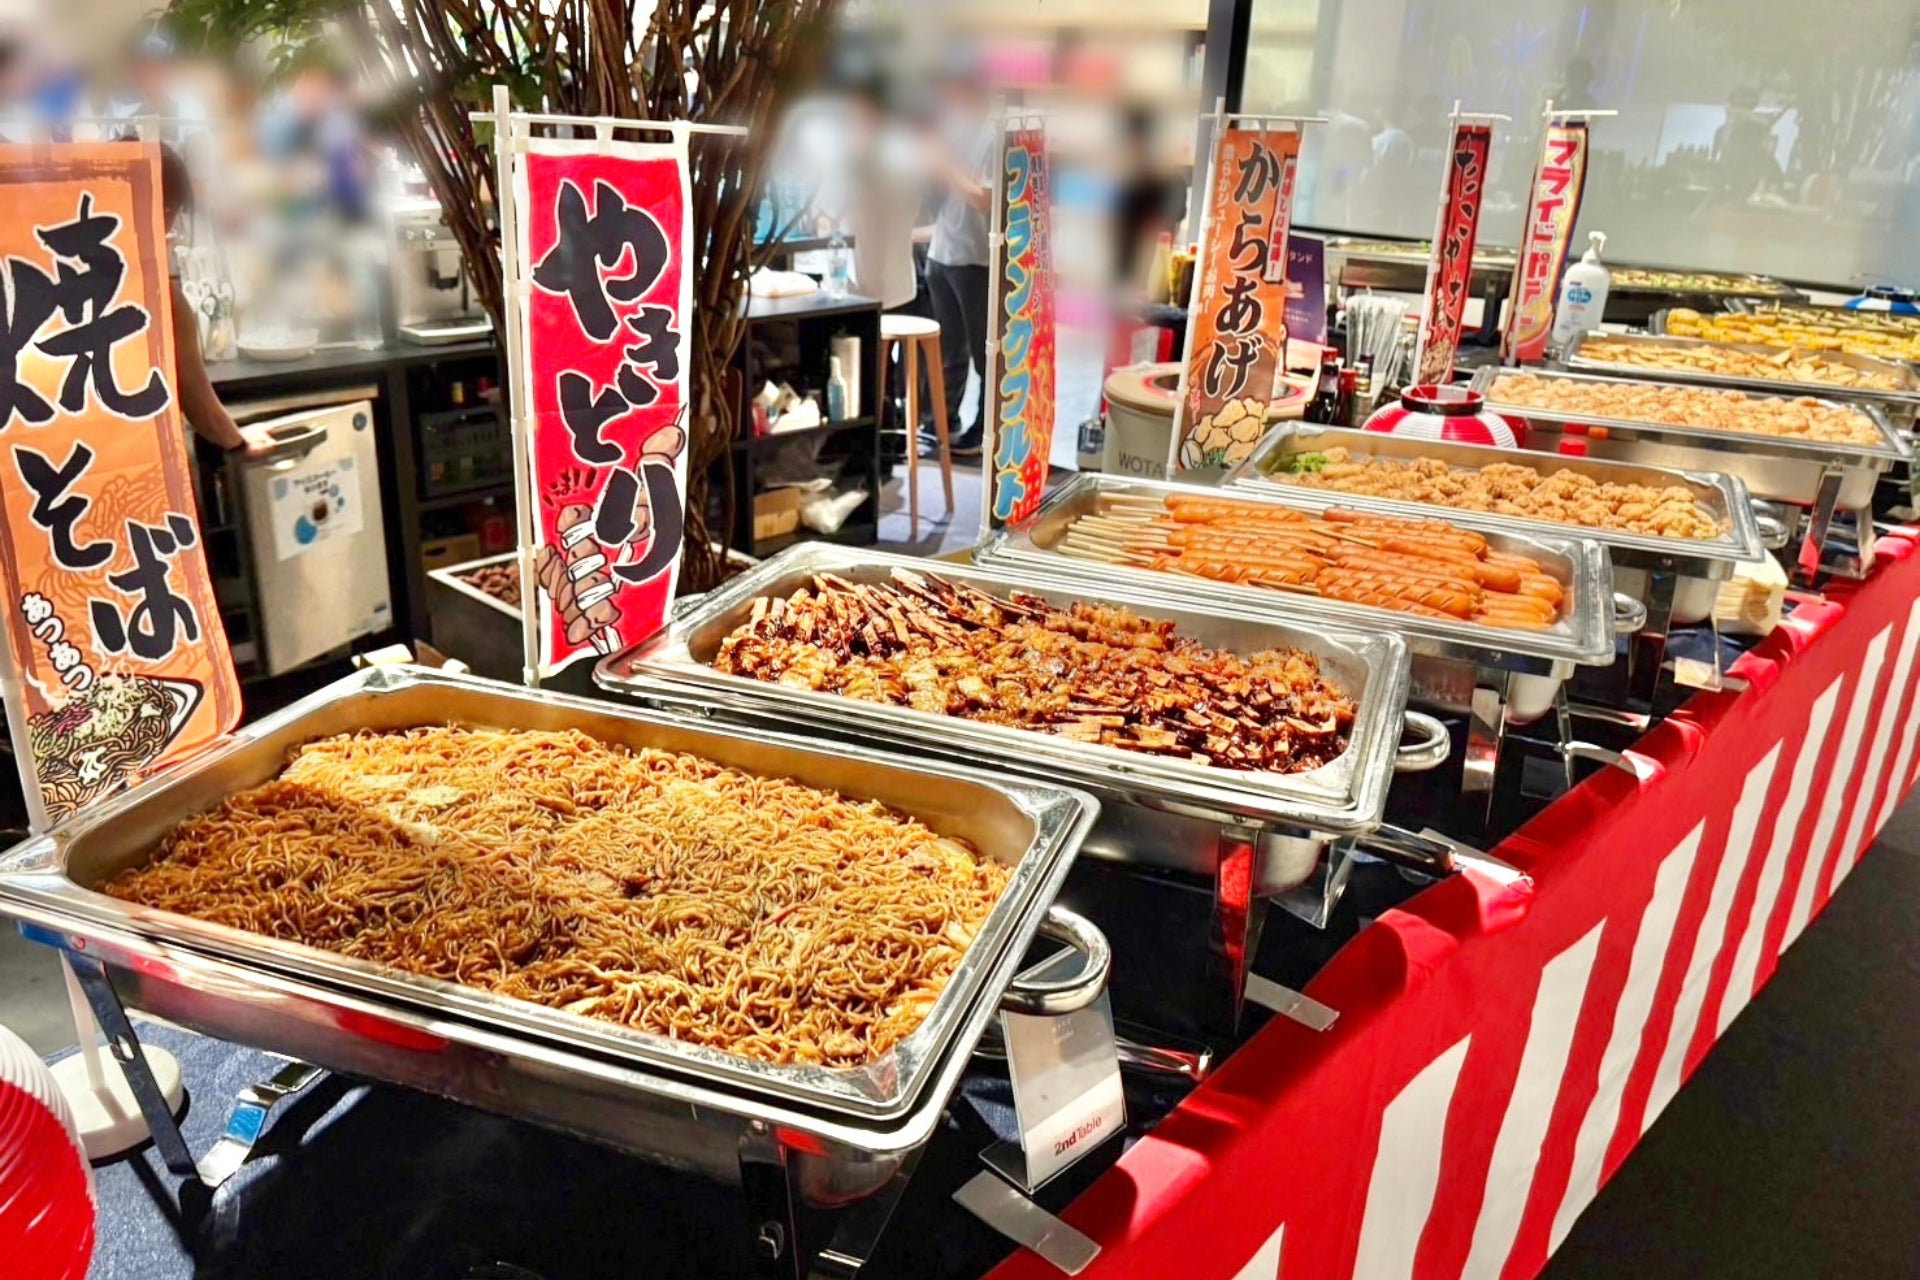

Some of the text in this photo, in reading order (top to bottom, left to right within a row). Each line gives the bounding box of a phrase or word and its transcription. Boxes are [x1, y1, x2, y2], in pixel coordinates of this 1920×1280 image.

[0, 193, 201, 662] 焼そば
[532, 178, 685, 584] やきとり
[993, 146, 1034, 519] フランクフルト
[1204, 140, 1280, 400] からあげ
[21, 593, 95, 693] あつあつ
